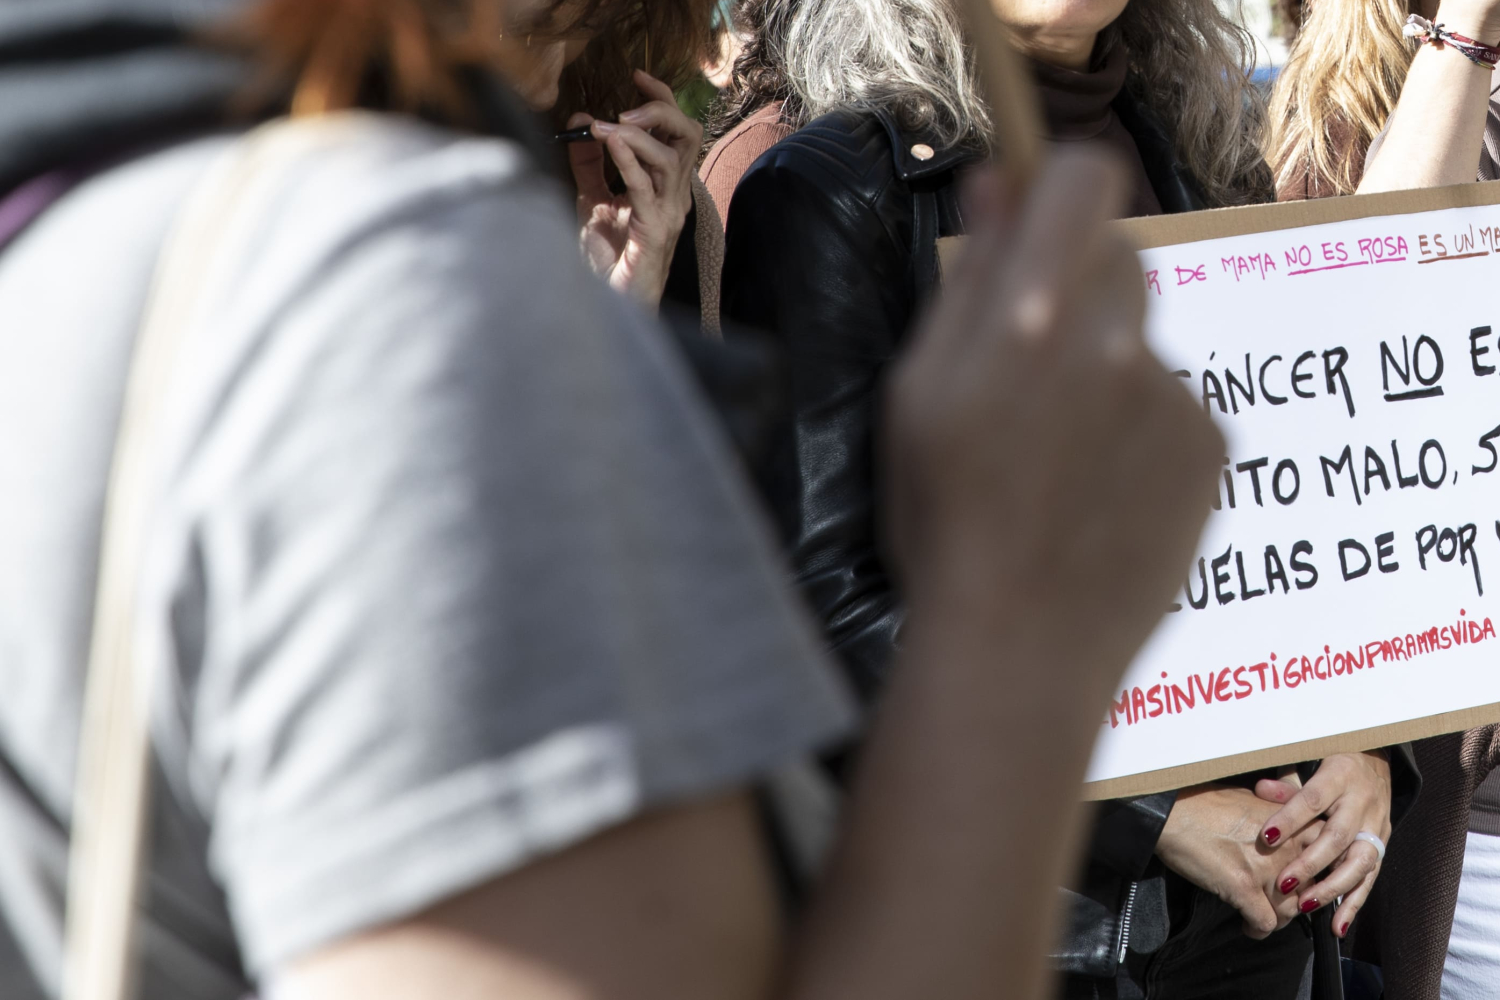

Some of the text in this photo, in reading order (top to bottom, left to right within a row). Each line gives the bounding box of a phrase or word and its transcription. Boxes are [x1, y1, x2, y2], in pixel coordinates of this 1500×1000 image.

[1174, 254, 1207, 286] DE
[1221, 253, 1276, 281] MAMA
[1285, 245, 1311, 267] NO
[1321, 242, 1348, 262] ES
[1358, 236, 1408, 264] ROSA
[1418, 234, 1447, 257] ES
[1454, 224, 1474, 253] UN
[1170, 346, 1355, 417] ÁNCER
[1380, 334, 1444, 391] NO
[1319, 438, 1458, 506] MALO,
[1165, 540, 1319, 613] UELAS
[1338, 532, 1399, 583] DE
[1415, 526, 1483, 597] POR
